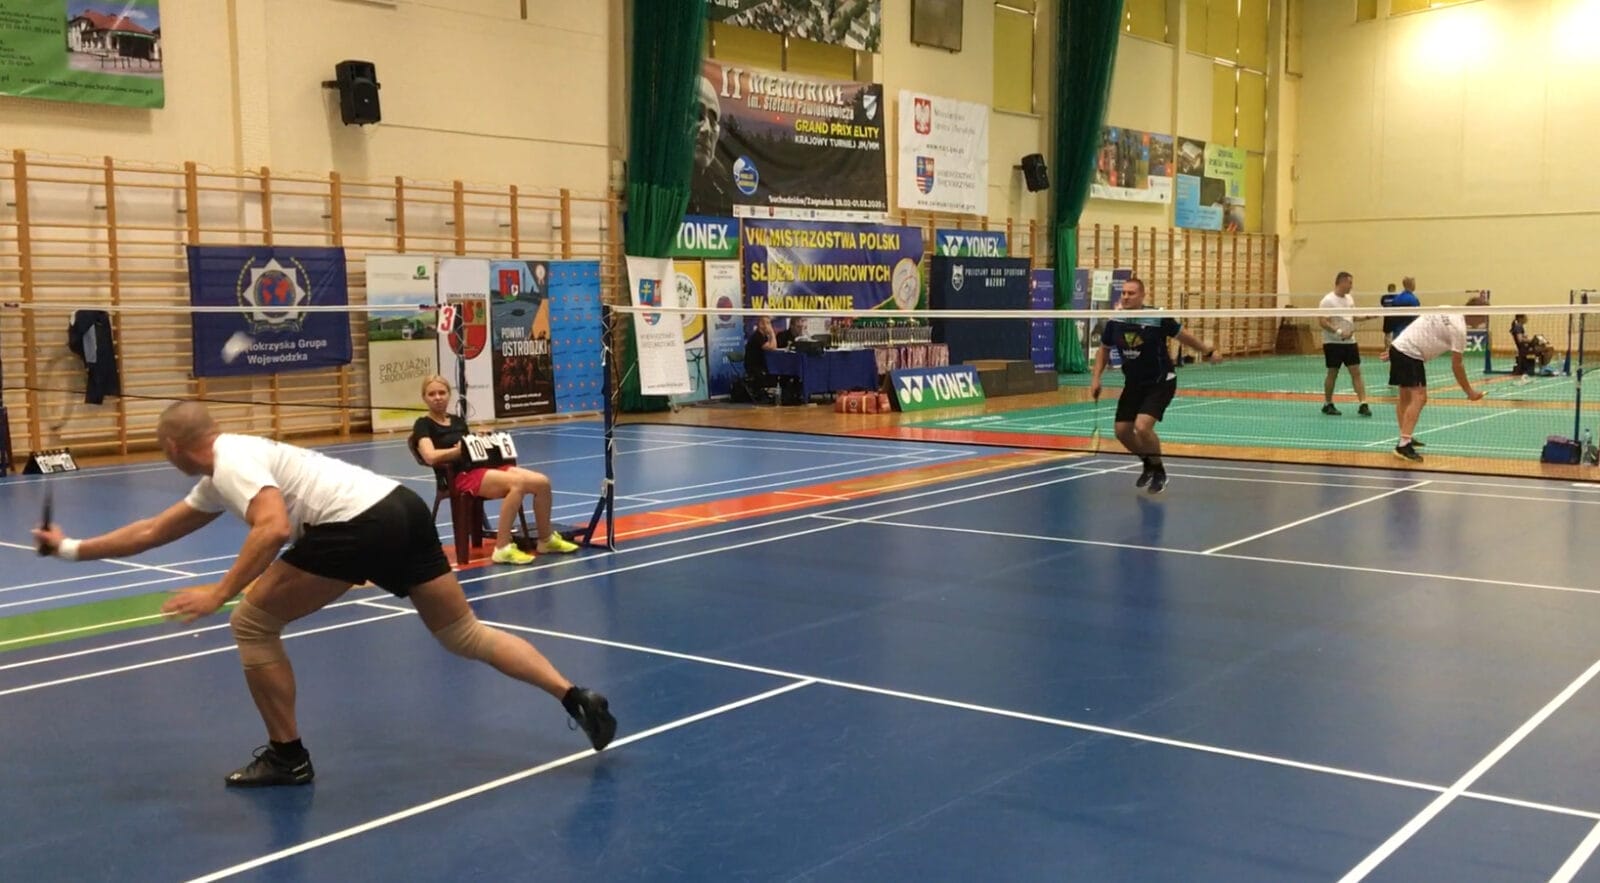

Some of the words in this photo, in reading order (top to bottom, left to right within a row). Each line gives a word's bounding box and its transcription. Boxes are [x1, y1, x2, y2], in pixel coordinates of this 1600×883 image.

[720, 67, 744, 99] II
[749, 73, 844, 105] MEMORIAŁ
[795, 119, 829, 135] GRAND
[830, 123, 853, 137] PRIX
[853, 126, 880, 138] ELITY
[795, 135, 828, 147] KRAJOWY
[829, 138, 856, 149] TURNIEJ
[676, 222, 728, 250] YONEX
[769, 229, 857, 249] MISTRZOSTWA
[859, 232, 900, 250] POLSKI
[965, 235, 1000, 257] YONEX
[797, 264, 891, 282] MUNDUROWYCH
[752, 295, 762, 309] W
[768, 295, 853, 309] BADMINTONIE
[440, 307, 453, 331] 3
[501, 327, 525, 339] POWIAT
[298, 338, 327, 349] Grupa
[247, 352, 308, 366] Wojewódzka
[927, 371, 979, 400] YONEX
[469, 439, 485, 457] 10
[503, 438, 512, 456] 6
